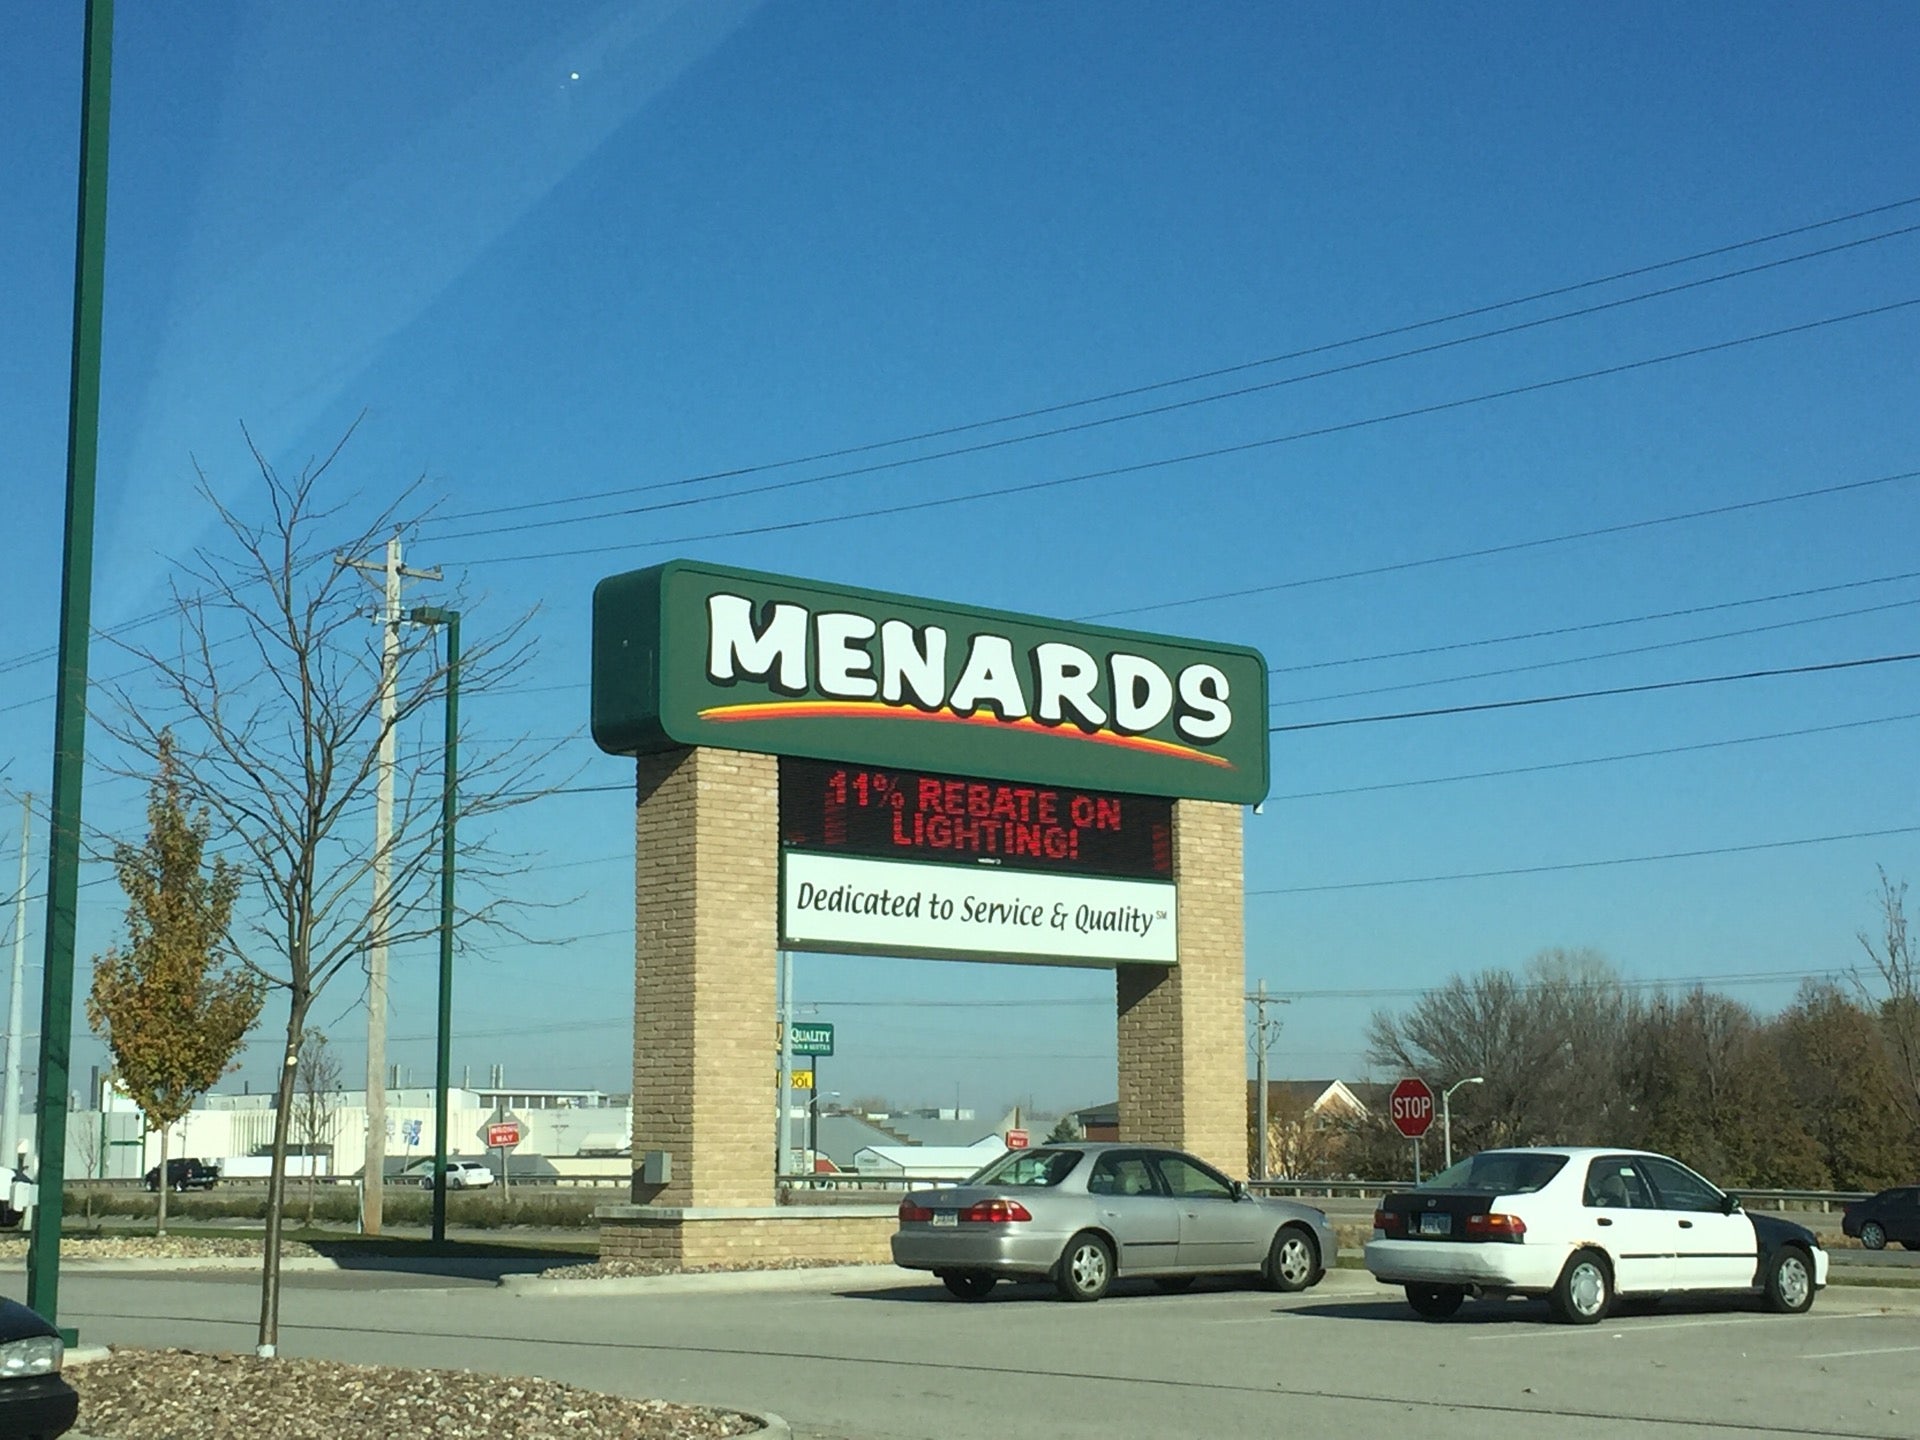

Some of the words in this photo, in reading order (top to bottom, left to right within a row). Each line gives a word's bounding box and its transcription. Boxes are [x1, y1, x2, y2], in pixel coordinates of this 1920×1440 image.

[706, 594, 1233, 742] MENARDS
[829, 770, 905, 808] 11%
[918, 777, 1058, 825] REBATE
[1070, 795, 1121, 831] ON
[893, 811, 1079, 860] LIGHTING!
[797, 881, 921, 919] Dedicated
[928, 893, 954, 920] to
[960, 895, 1044, 928] Service
[1049, 902, 1067, 931] &
[791, 1028, 831, 1043] QUALITY
[1393, 1096, 1431, 1119] STOP
